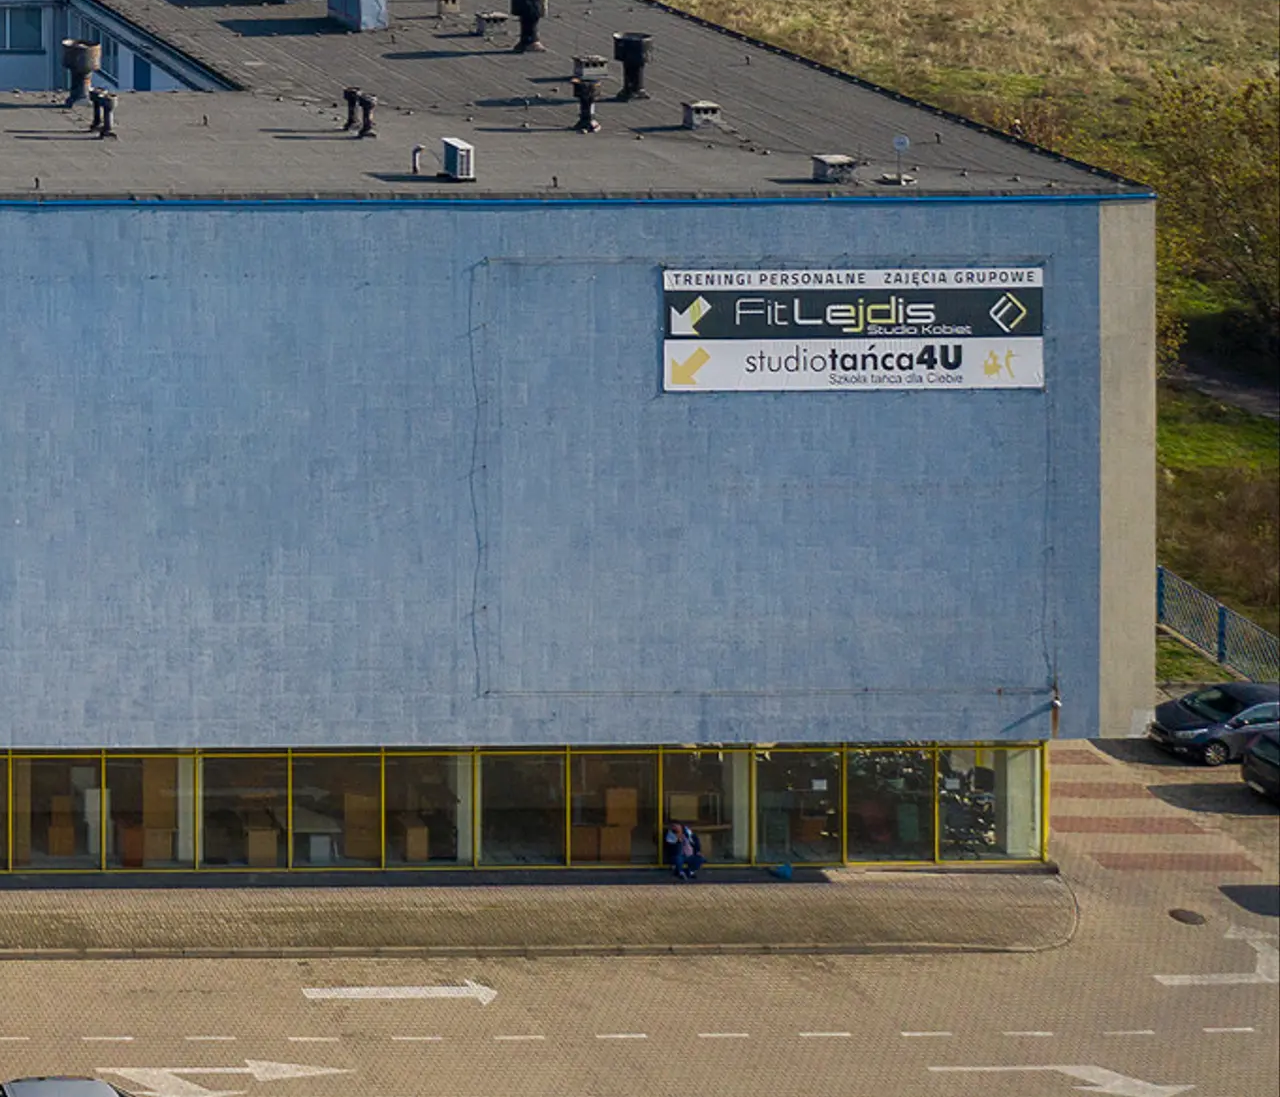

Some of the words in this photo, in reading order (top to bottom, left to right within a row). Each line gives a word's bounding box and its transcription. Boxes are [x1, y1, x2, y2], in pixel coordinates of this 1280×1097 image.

[673, 273, 752, 286] TRENINGI
[760, 272, 866, 285] PERSONALNE
[884, 272, 948, 287] ZAJĘCIA
[954, 271, 1035, 284] GRUPOWE
[735, 295, 936, 333] FitLejdis
[867, 324, 917, 335] Studio
[921, 324, 973, 335] Kobiet
